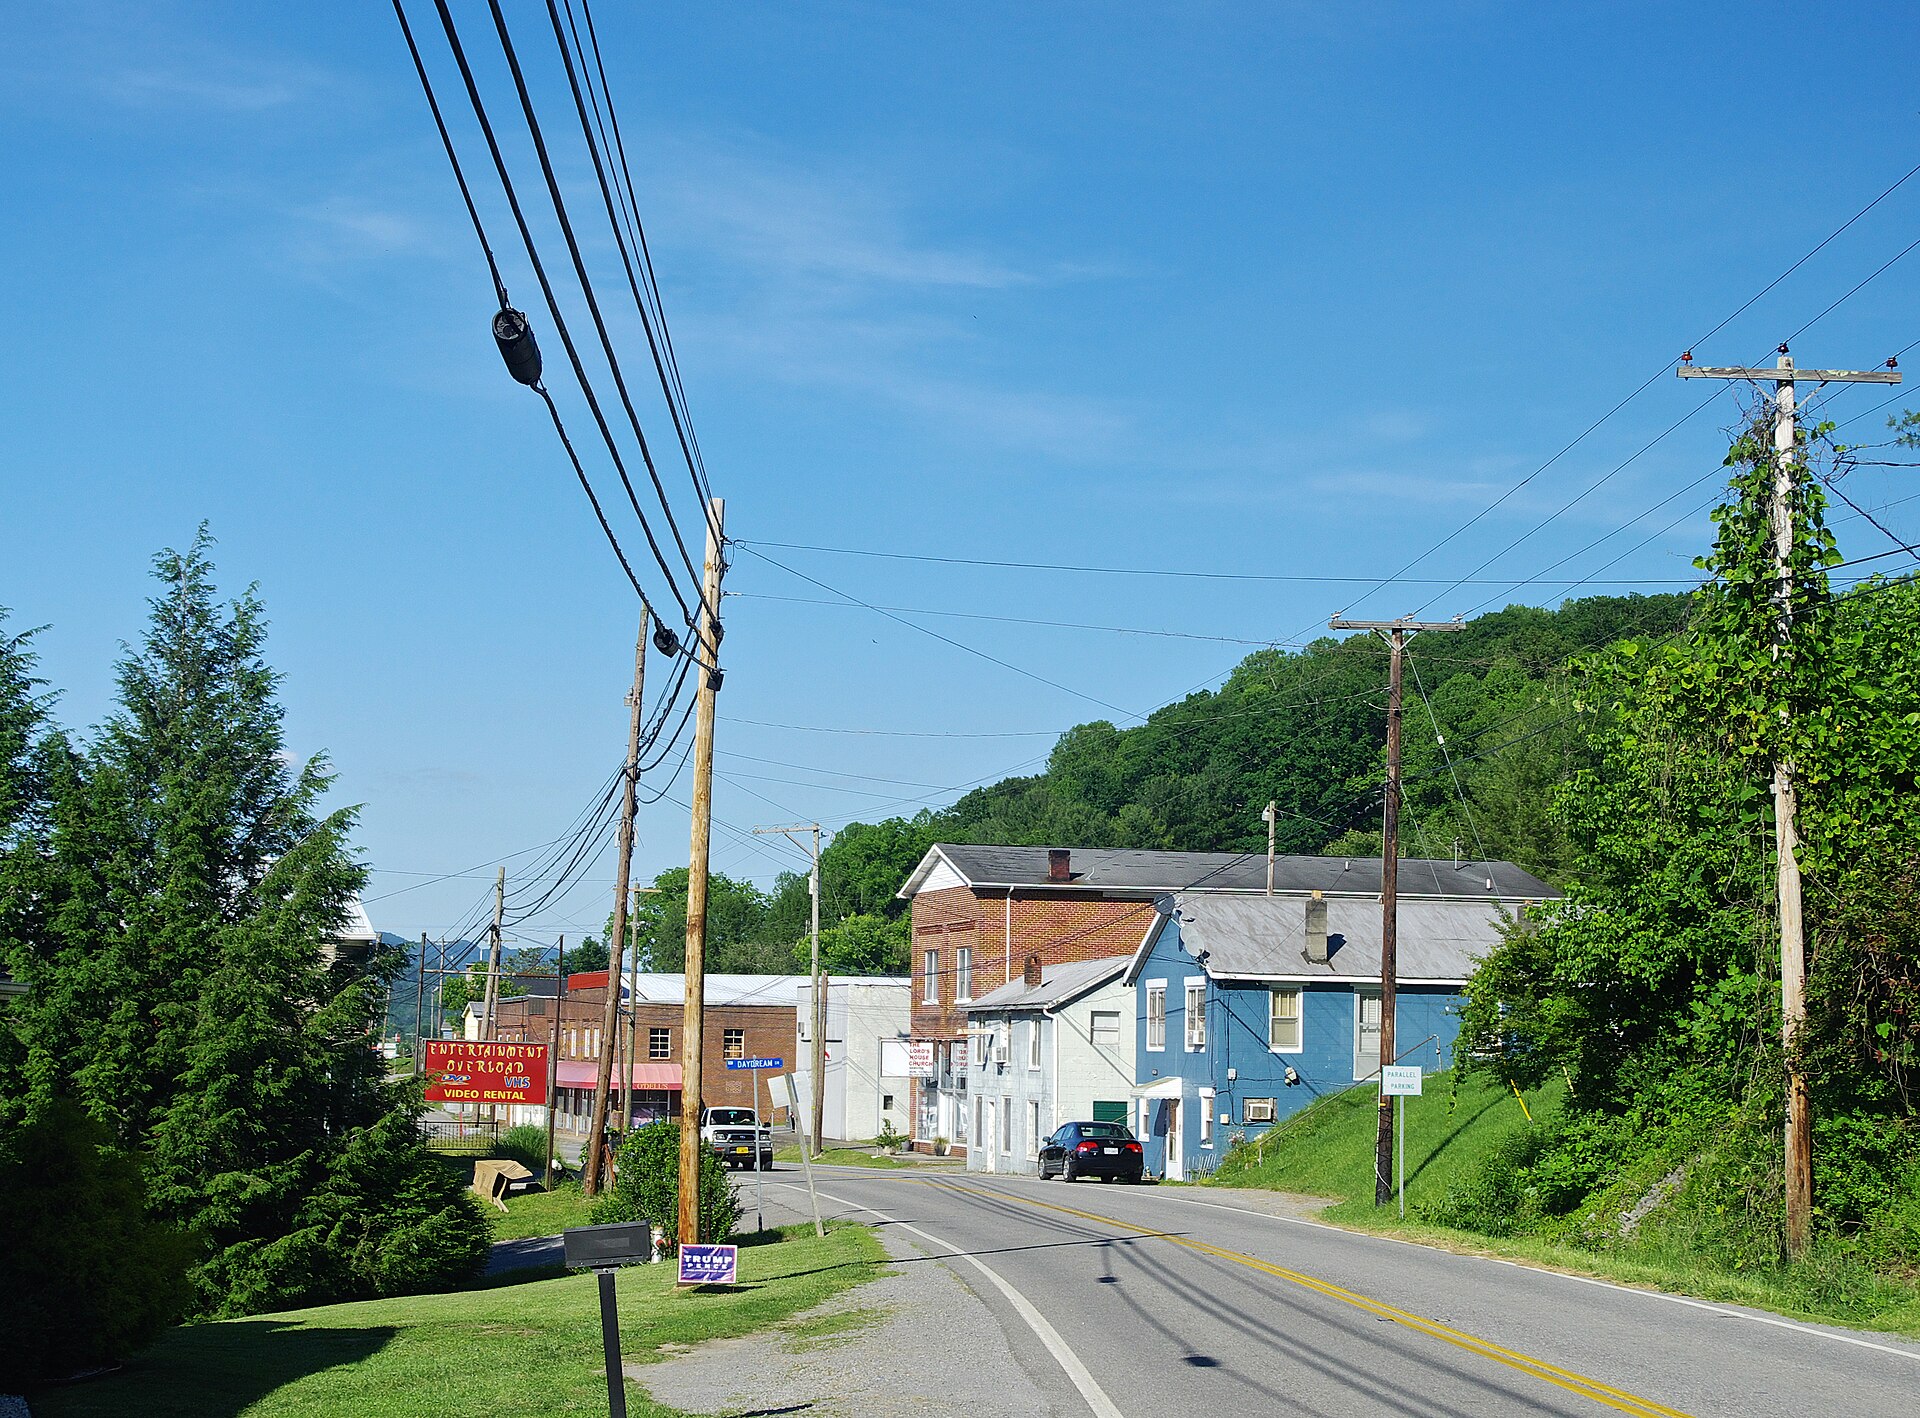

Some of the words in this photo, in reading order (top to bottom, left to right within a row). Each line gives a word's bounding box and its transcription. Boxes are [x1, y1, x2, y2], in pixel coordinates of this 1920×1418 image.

[429, 1043, 544, 1058] ENTERTAINMENT
[446, 1060, 524, 1075] OVERLOAD
[737, 1060, 773, 1068] DAYDREAM
[503, 1075, 531, 1089] VHS
[443, 1088, 480, 1099] VIDEO
[483, 1090, 526, 1100] RENTAL
[683, 1255, 733, 1264] TRUMP
